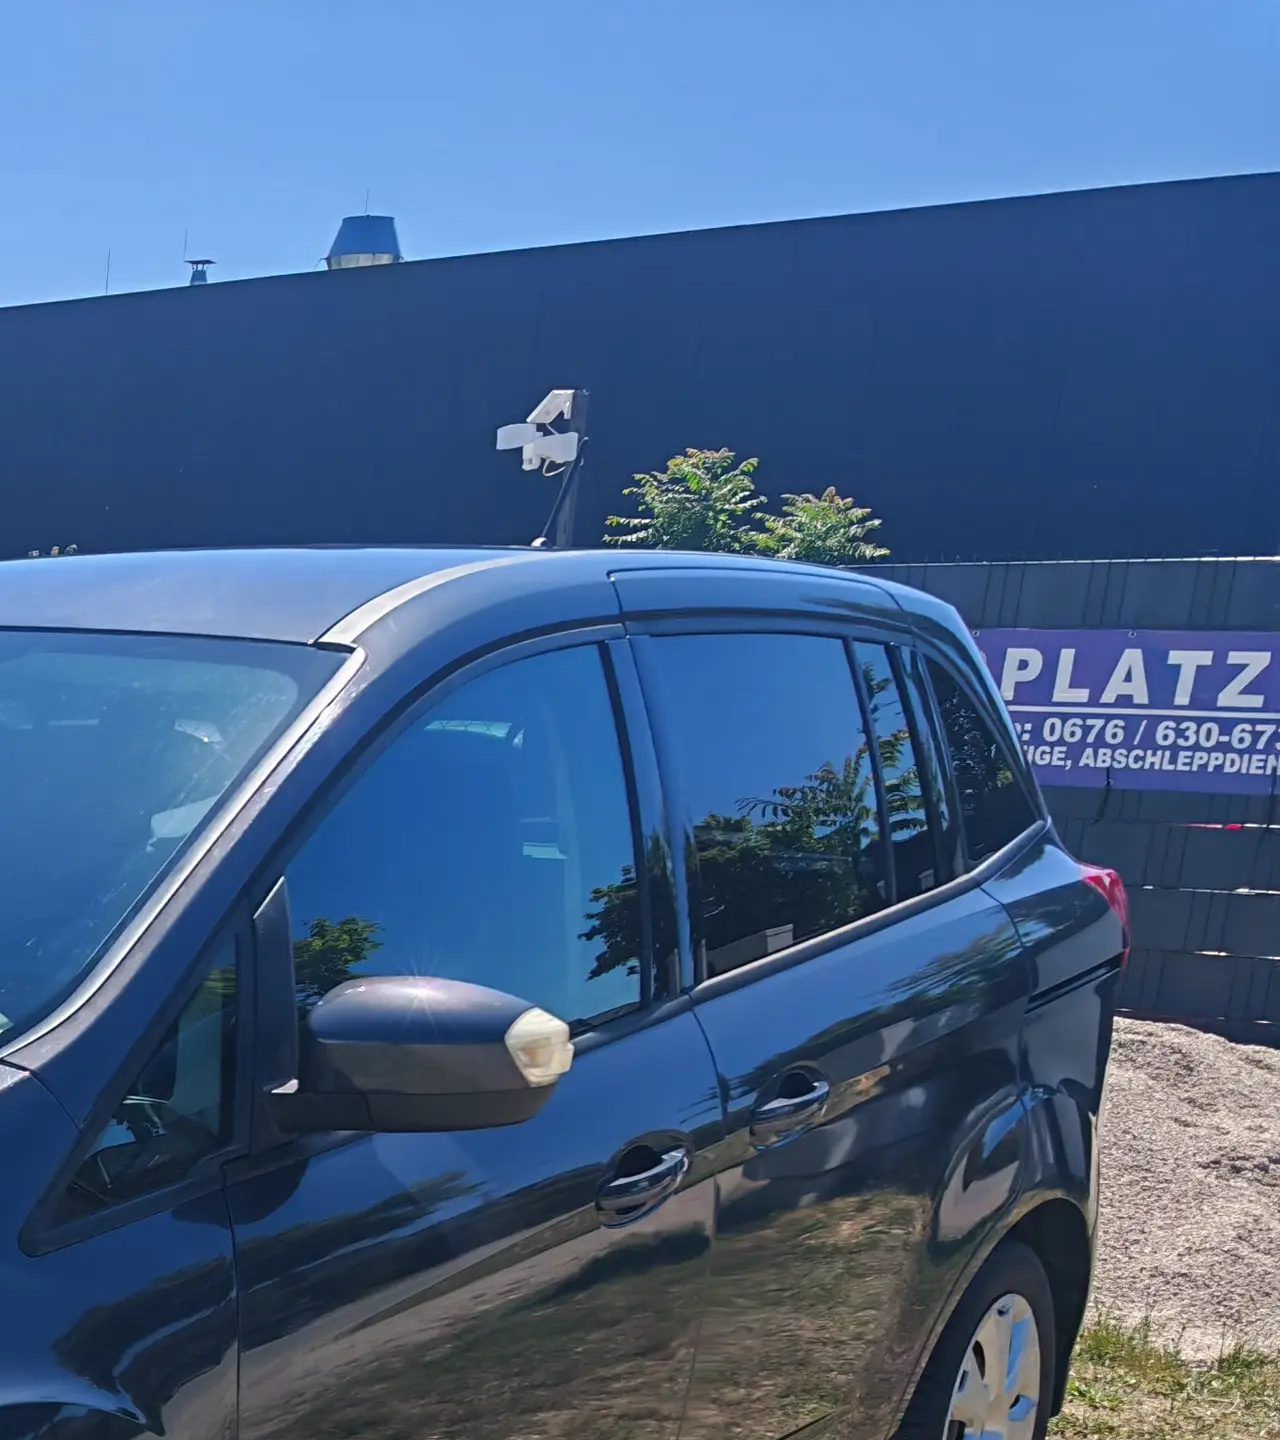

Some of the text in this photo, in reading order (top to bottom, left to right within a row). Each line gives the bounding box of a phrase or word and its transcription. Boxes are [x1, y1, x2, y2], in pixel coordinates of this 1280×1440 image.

[979, 647, 1272, 708] PLATZ
[1042, 717, 1126, 745] 0676
[1133, 720, 1148, 745] /
